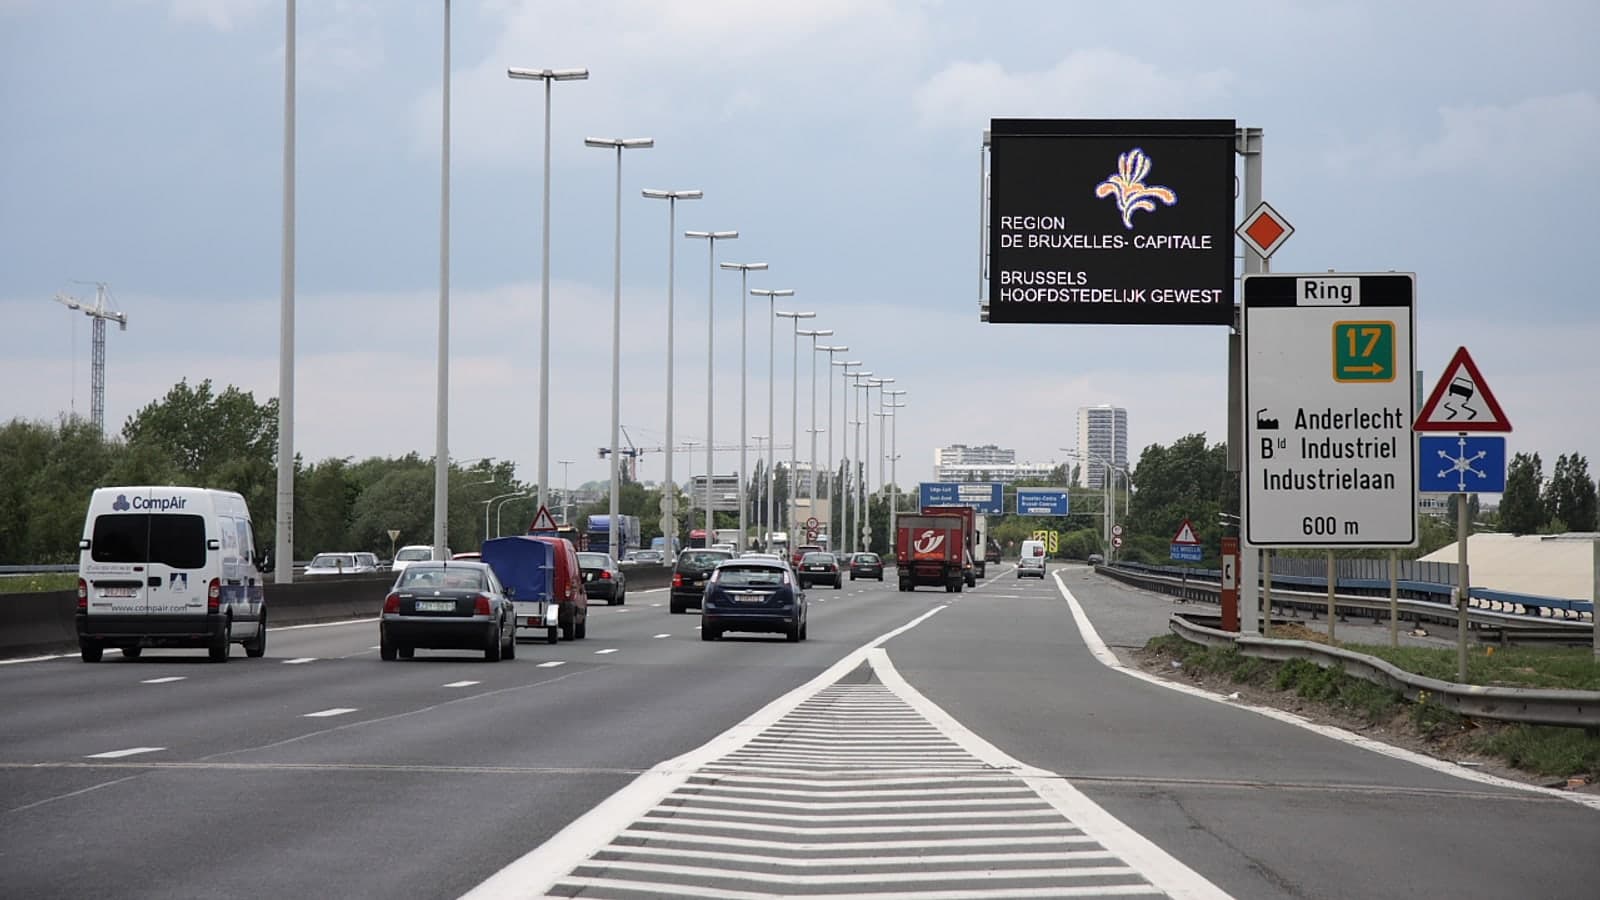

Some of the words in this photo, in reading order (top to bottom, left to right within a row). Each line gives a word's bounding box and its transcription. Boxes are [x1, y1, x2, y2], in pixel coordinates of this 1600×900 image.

[1000, 215, 1065, 231] REGION
[1000, 235, 1023, 249] DE
[1028, 235, 1129, 249] BRUXELLES-
[1133, 235, 1213, 250] CAPITALE
[1000, 271, 1088, 286] BRUSSELS
[1000, 288, 1146, 304] HOOFDSTEDELIJK
[1150, 289, 1223, 304] GEWEST
[1304, 280, 1353, 304] Ring
[1346, 327, 1382, 357] 17
[1294, 407, 1404, 430] Anderlecht
[1301, 436, 1397, 459] Industriel
[1263, 468, 1395, 490] Industrielaan
[132, 495, 187, 512] CompAir
[1302, 516, 1336, 535] 600
[1344, 522, 1359, 535] m
[111, 604, 188, 615] www.compair.com
